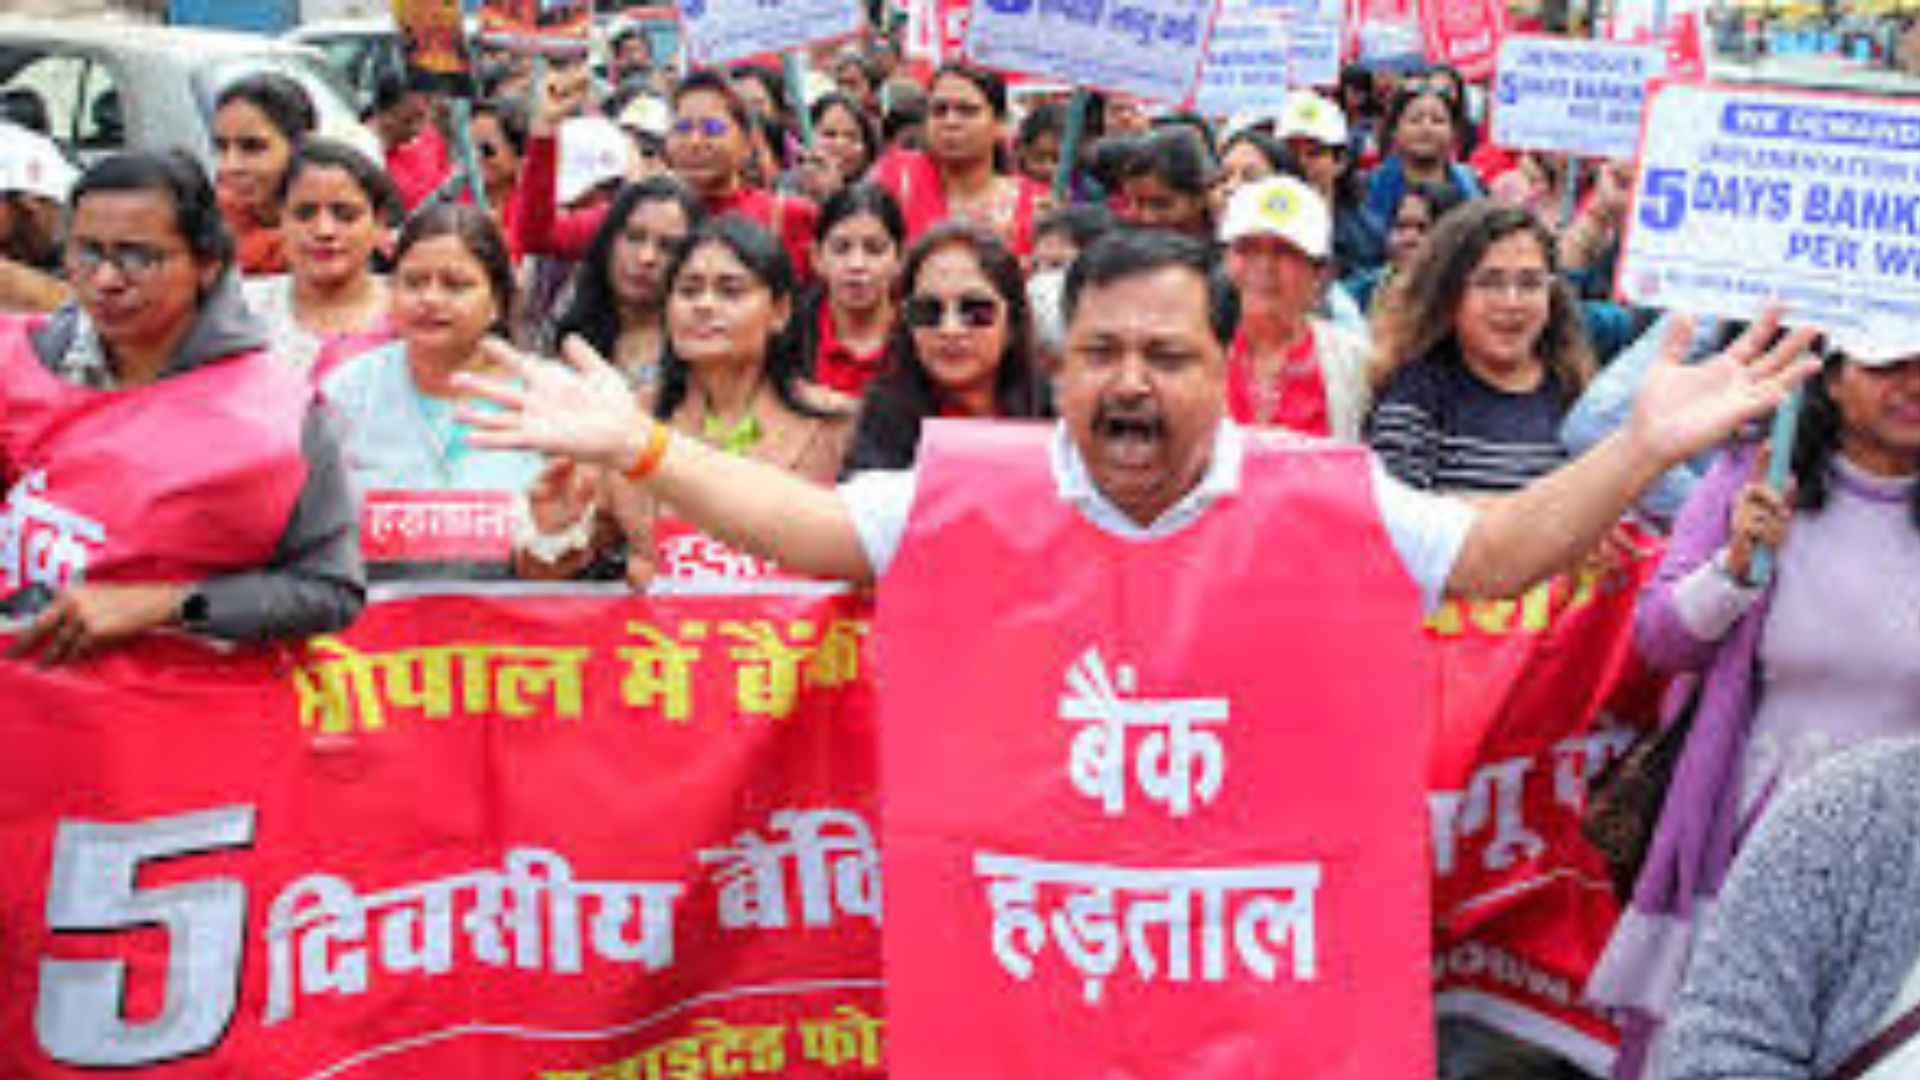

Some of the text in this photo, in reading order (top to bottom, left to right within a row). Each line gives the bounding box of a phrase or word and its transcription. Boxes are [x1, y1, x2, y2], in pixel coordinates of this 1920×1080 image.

[1639, 167, 1687, 231] 5
[1692, 171, 1792, 220] DAYS
[1785, 230, 1859, 269] PER
[616, 619, 702, 721] में
[1058, 644, 1230, 815] बैंक
[34, 804, 257, 1069] 5
[262, 848, 683, 1026] दिवसीय
[972, 852, 1321, 1007] हड़ताल
